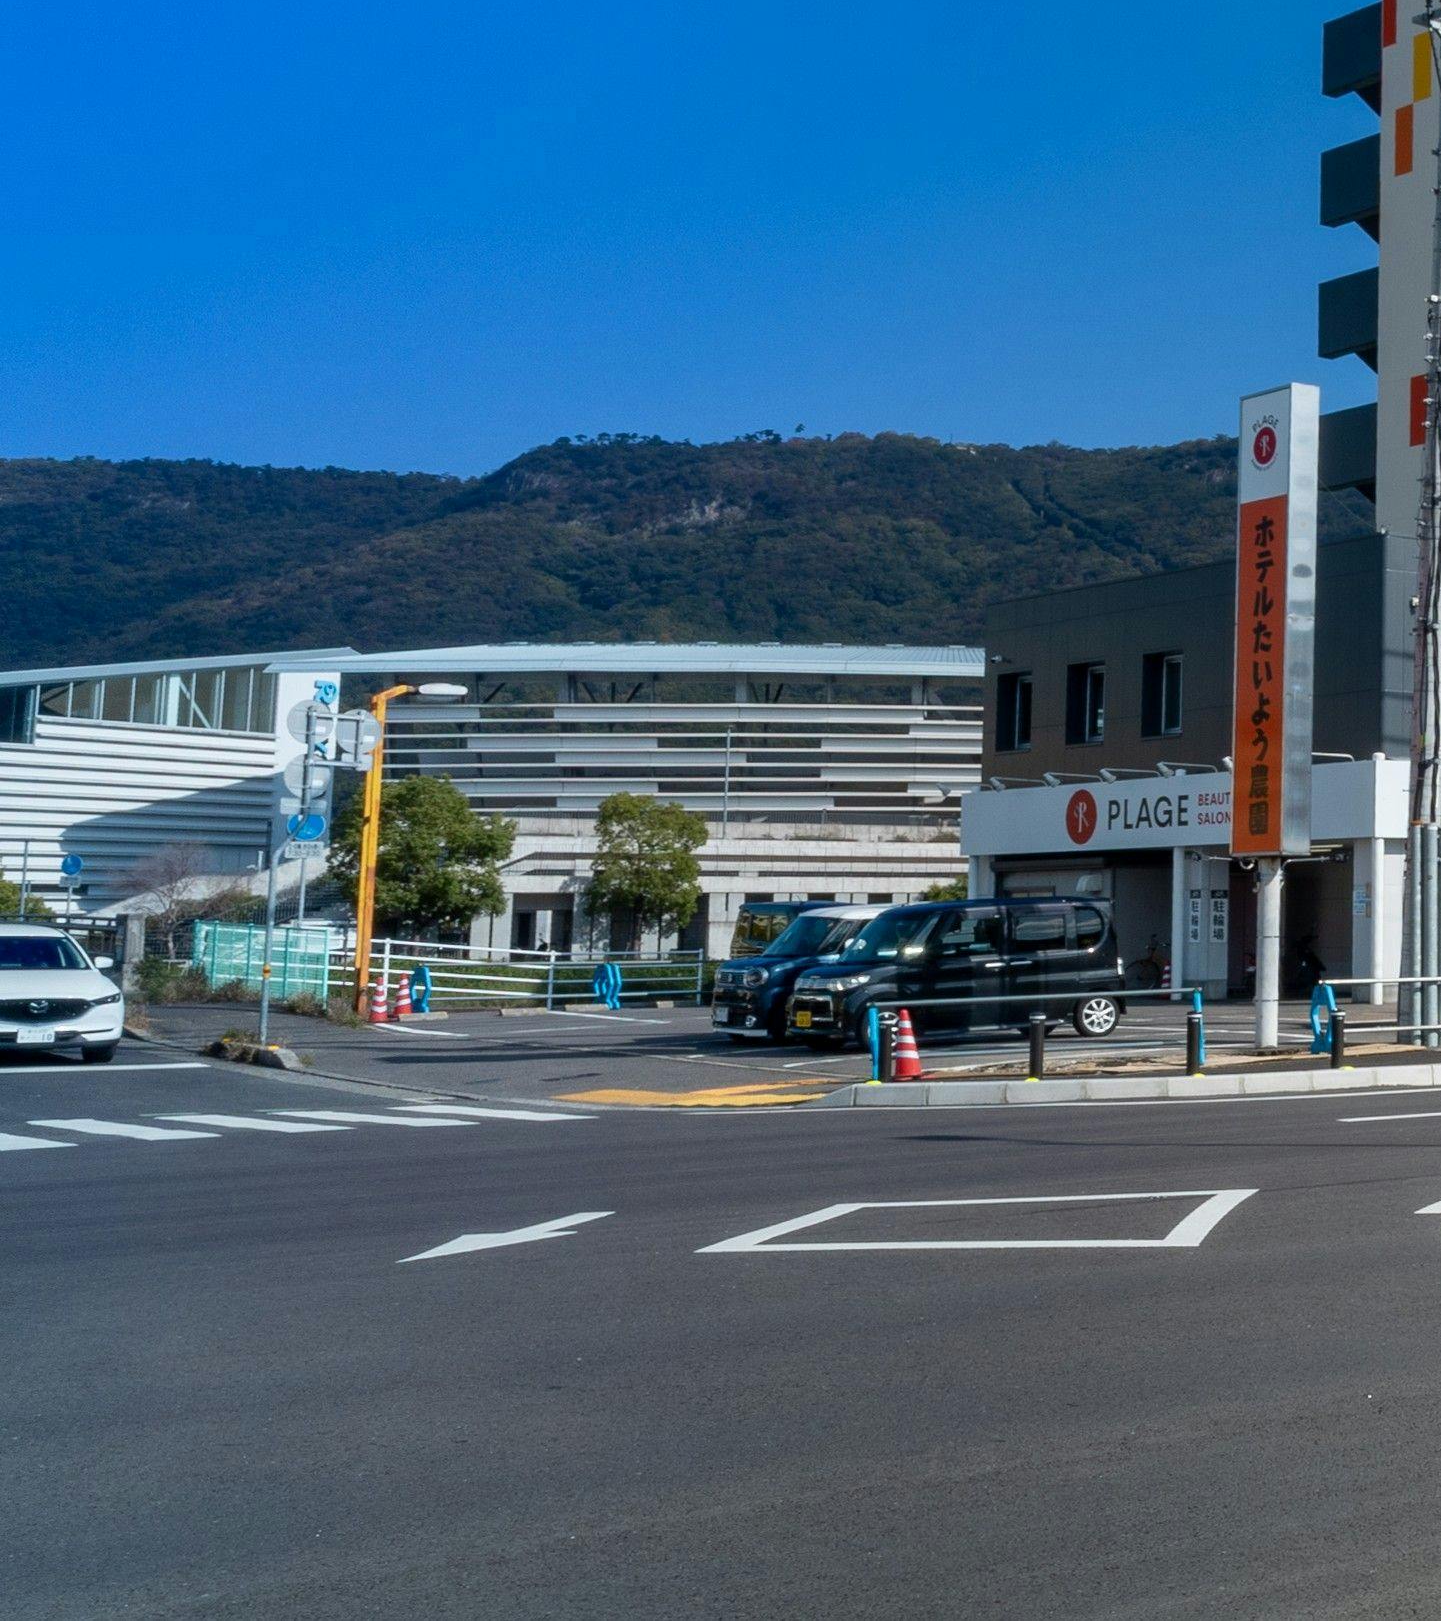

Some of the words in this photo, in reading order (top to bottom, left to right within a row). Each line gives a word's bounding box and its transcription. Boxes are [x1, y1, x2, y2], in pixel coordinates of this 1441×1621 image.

[1248, 515, 1275, 836] ホテルたいよう農園
[1198, 791, 1231, 806] BEAUT
[1108, 795, 1189, 830] PLAGE
[1198, 811, 1231, 825] SALON
